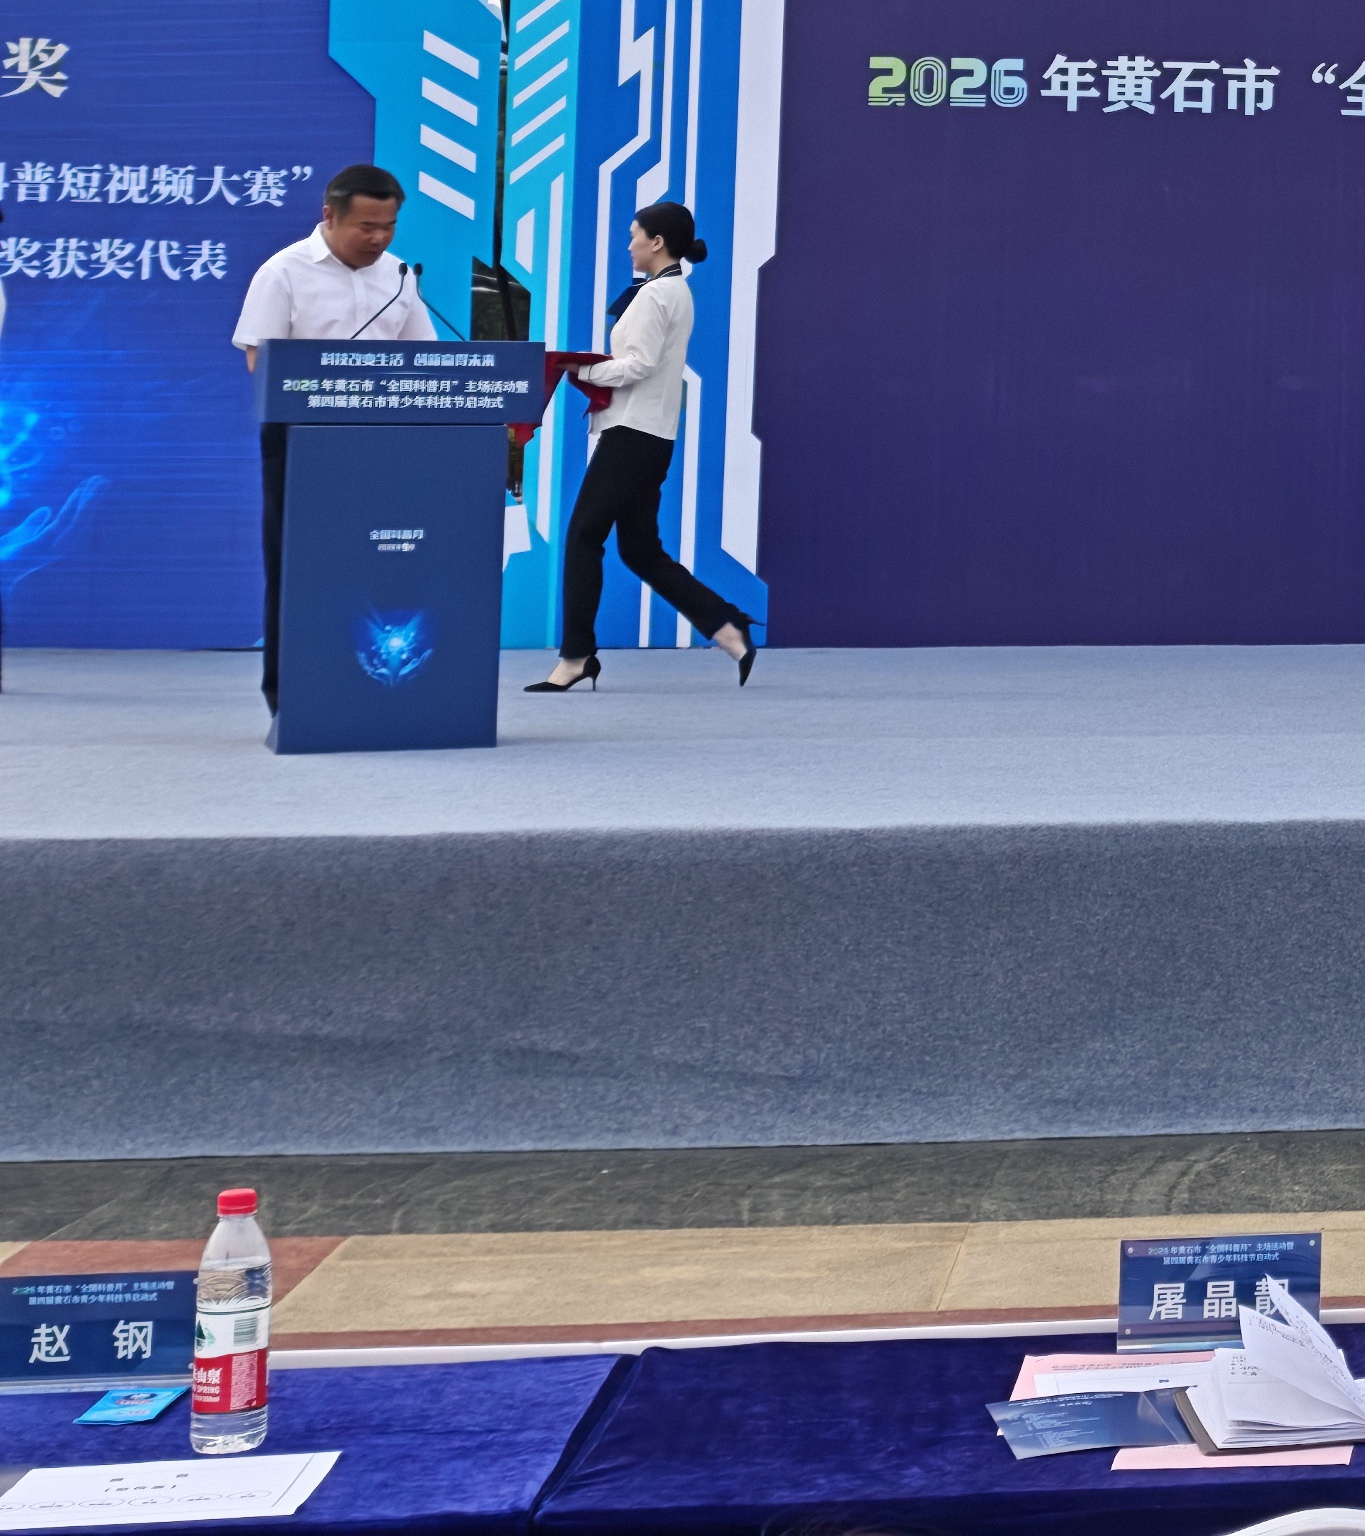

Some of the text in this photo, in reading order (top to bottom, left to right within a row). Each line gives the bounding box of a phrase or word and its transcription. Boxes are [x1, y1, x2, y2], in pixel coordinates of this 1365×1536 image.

[2, 37, 70, 98] 奖
[0, 161, 313, 208] 普短视频大赛”
